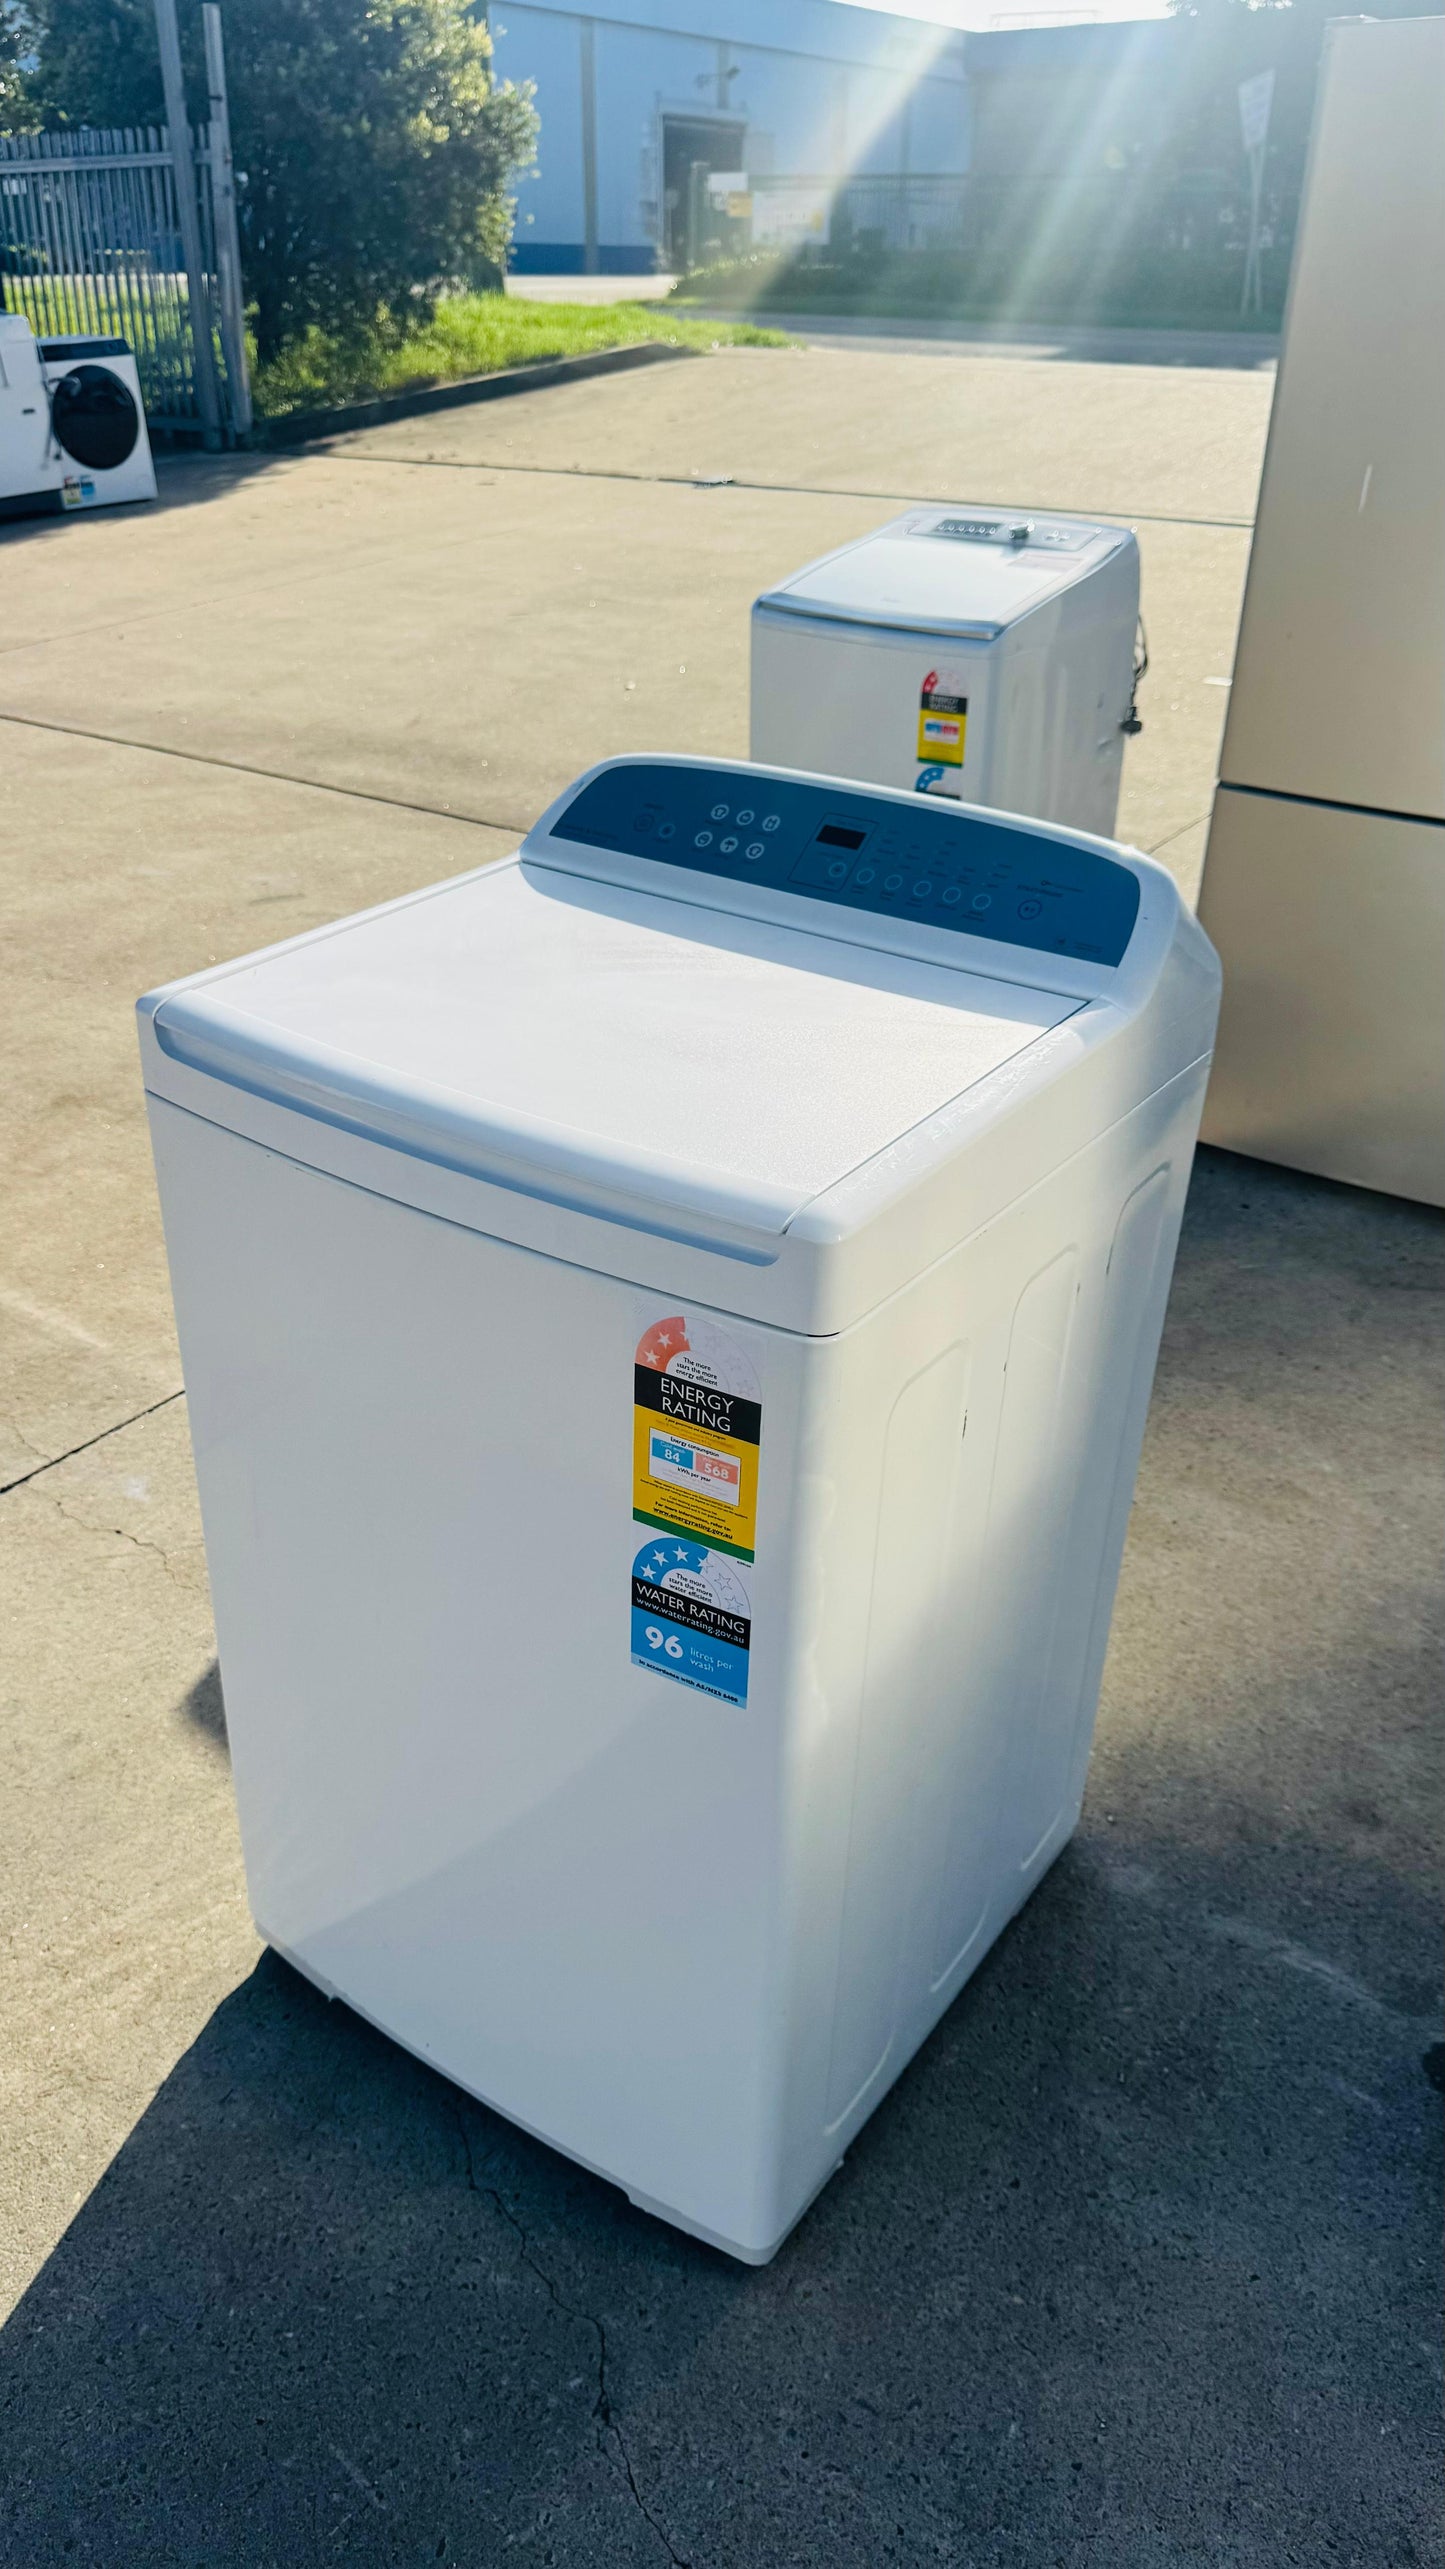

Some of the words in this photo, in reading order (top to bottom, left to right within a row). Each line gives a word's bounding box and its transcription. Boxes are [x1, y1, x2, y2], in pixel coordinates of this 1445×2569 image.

[676, 1362, 690, 1370] stars
[691, 1366, 700, 1374] the
[701, 1371, 717, 1379] more
[683, 1357, 694, 1365] The
[695, 1362, 711, 1370] more
[675, 1369, 694, 1379] energy
[660, 1377, 734, 1414] ENERGY
[662, 1396, 731, 1432] RATING
[664, 1448, 680, 1462] 84
[670, 1437, 686, 1446] Energy
[687, 1443, 719, 1457] consumption
[690, 1471, 698, 1479] per
[700, 1475, 711, 1483] year
[703, 1462, 729, 1479] 568
[655, 1500, 663, 1508] For
[664, 1504, 677, 1512] more
[653, 1508, 732, 1539] www.energyrating.gov.au
[668, 1577, 683, 1586] stars
[695, 1588, 712, 1596] more
[676, 1573, 688, 1581] The
[689, 1579, 705, 1588] more
[668, 1583, 686, 1593] water
[687, 1590, 712, 1602] efficient
[636, 1582, 685, 1611] WATER
[689, 1603, 745, 1633] RATING
[636, 1598, 744, 1644] www.waterrating.gov.au
[644, 1625, 684, 1659] 96
[689, 1647, 714, 1663] litres
[716, 1659, 733, 1672] per
[689, 1656, 713, 1672] wash
[680, 1676, 694, 1685] with
